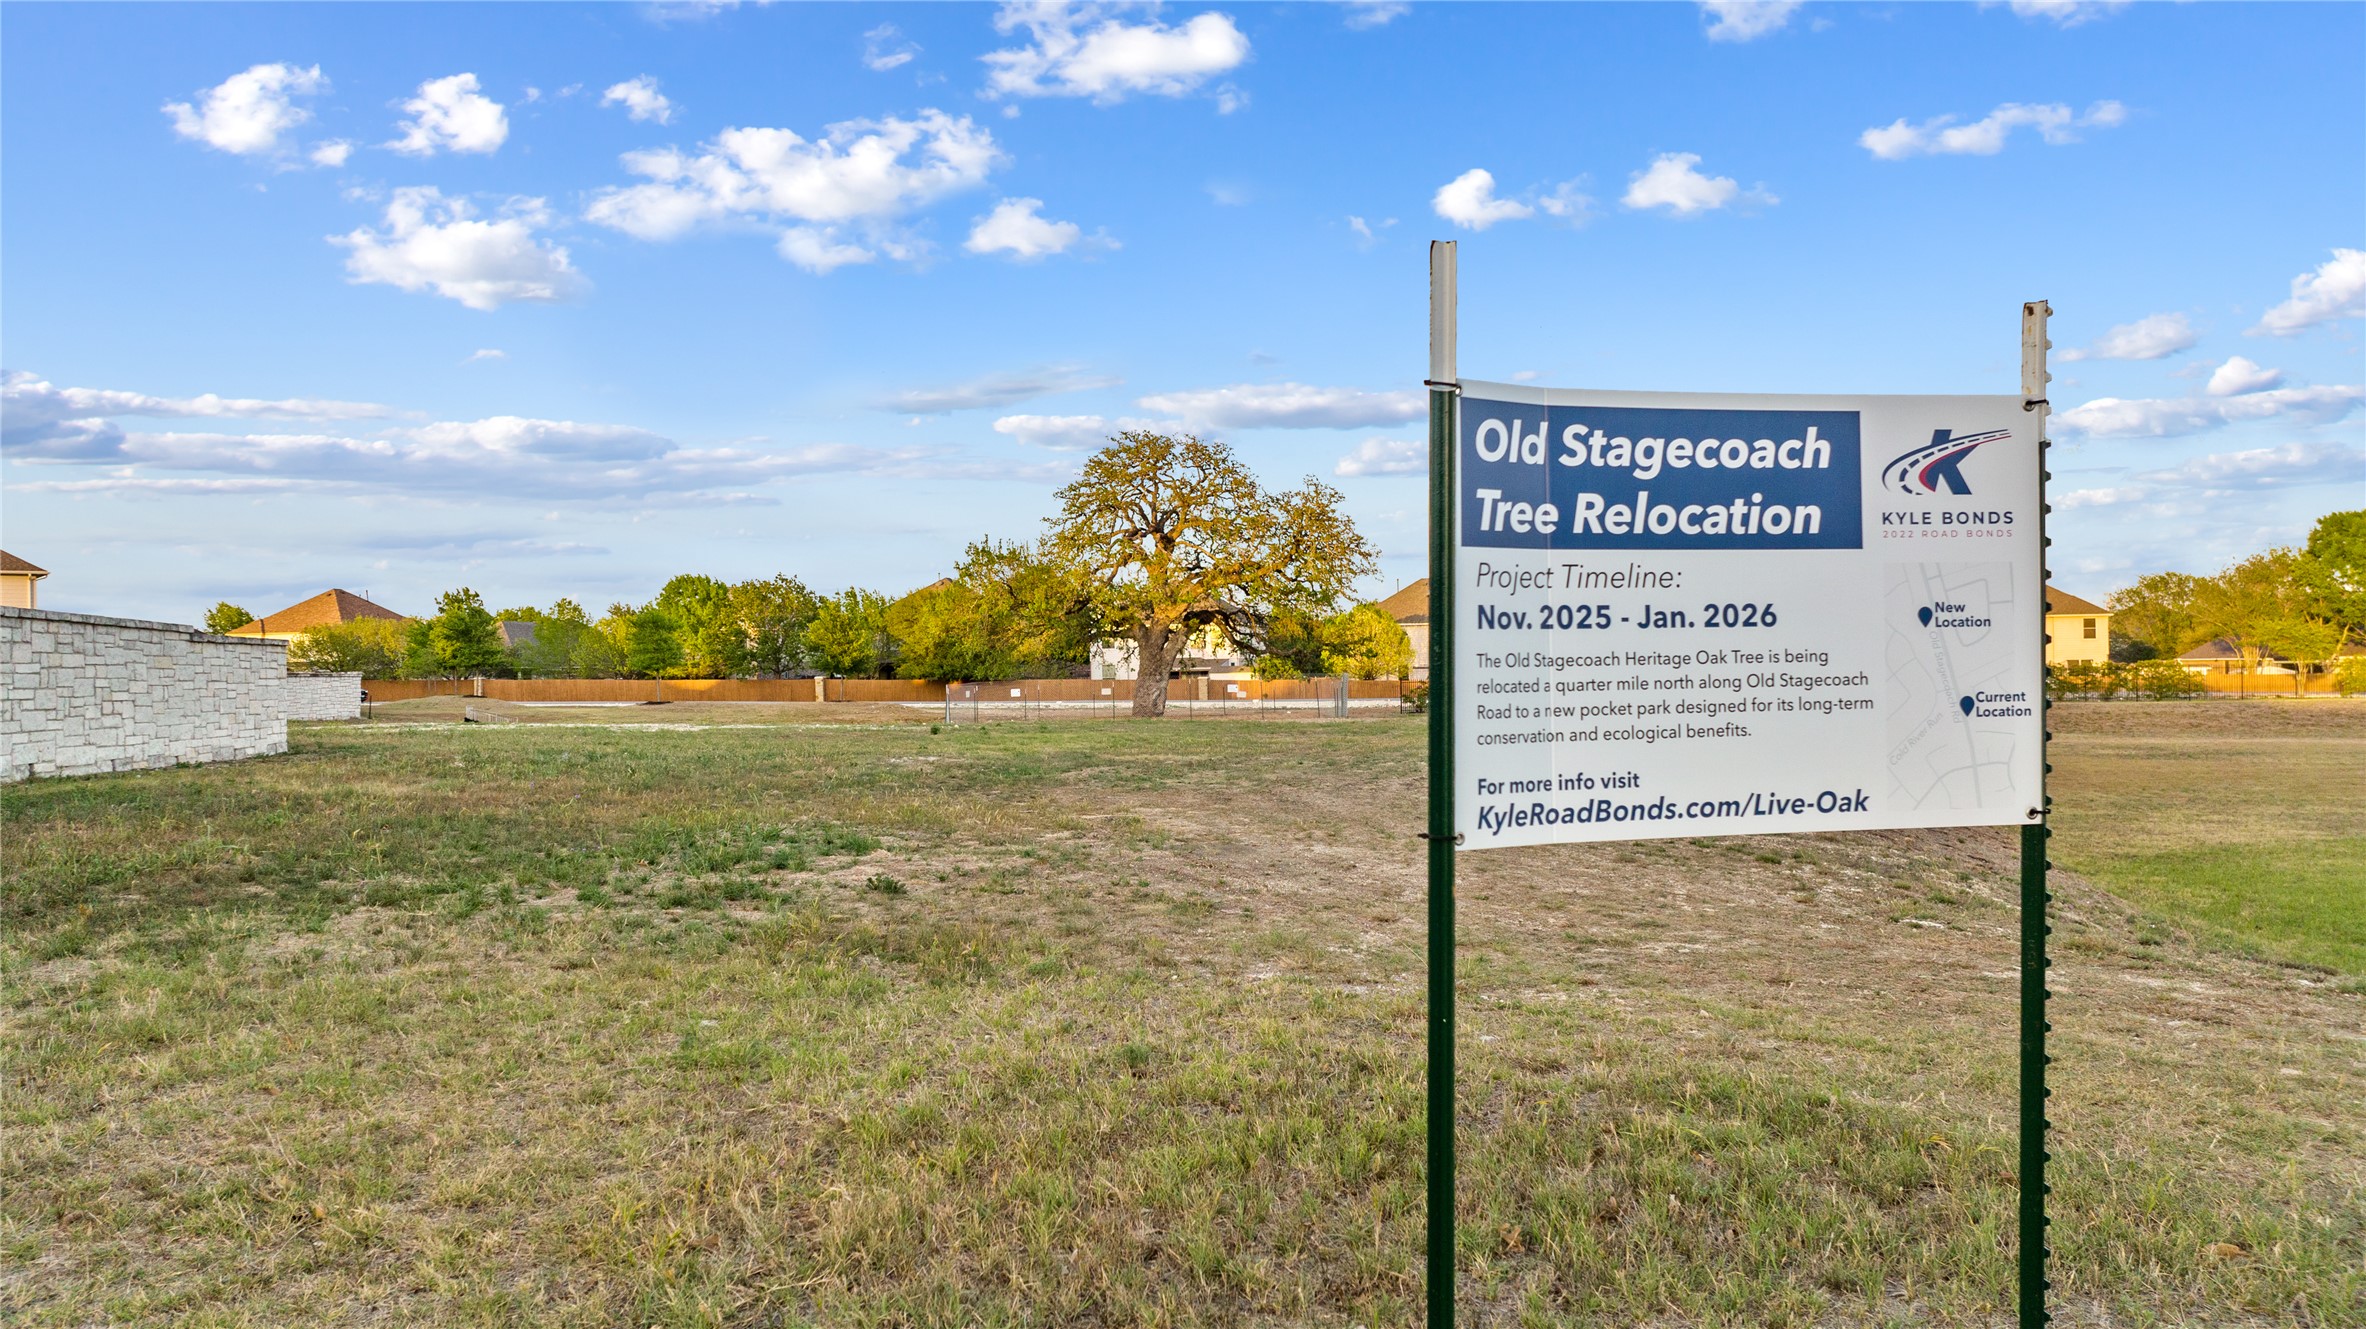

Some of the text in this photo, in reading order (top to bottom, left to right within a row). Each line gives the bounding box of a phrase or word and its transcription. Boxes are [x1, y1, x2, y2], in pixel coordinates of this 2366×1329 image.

[1475, 418, 1831, 480] Old Stagecoach
[1476, 488, 1822, 535] Tree Relocation
[1882, 511, 2014, 525] KYLE BONDS
[1883, 529, 2013, 538] 2022 ROAD BONDS
[1476, 562, 1682, 596] Project Timeline:
[1477, 605, 1532, 630] Nov.
[1540, 604, 1611, 629] 2025
[1637, 605, 1695, 628] Jan.
[1703, 603, 1777, 628] 2026
[1935, 602, 1966, 613] New
[1935, 616, 1991, 628] Location
[1476, 649, 1828, 671] The Old Stagecoach Heritage Oak Tree is being
[1477, 671, 1869, 696] relocated a quarter mile north along Old Stagecoach
[1477, 696, 1874, 720] Road to a new pocket park designed for its long-term
[1975, 691, 2026, 702] Current
[1976, 705, 2032, 717] Location
[1477, 722, 1752, 745] conservation and ecological benefits.
[1478, 772, 1640, 795] For more info visit
[1477, 788, 1869, 836] KyleRoadBonds.com/Live-Oak
